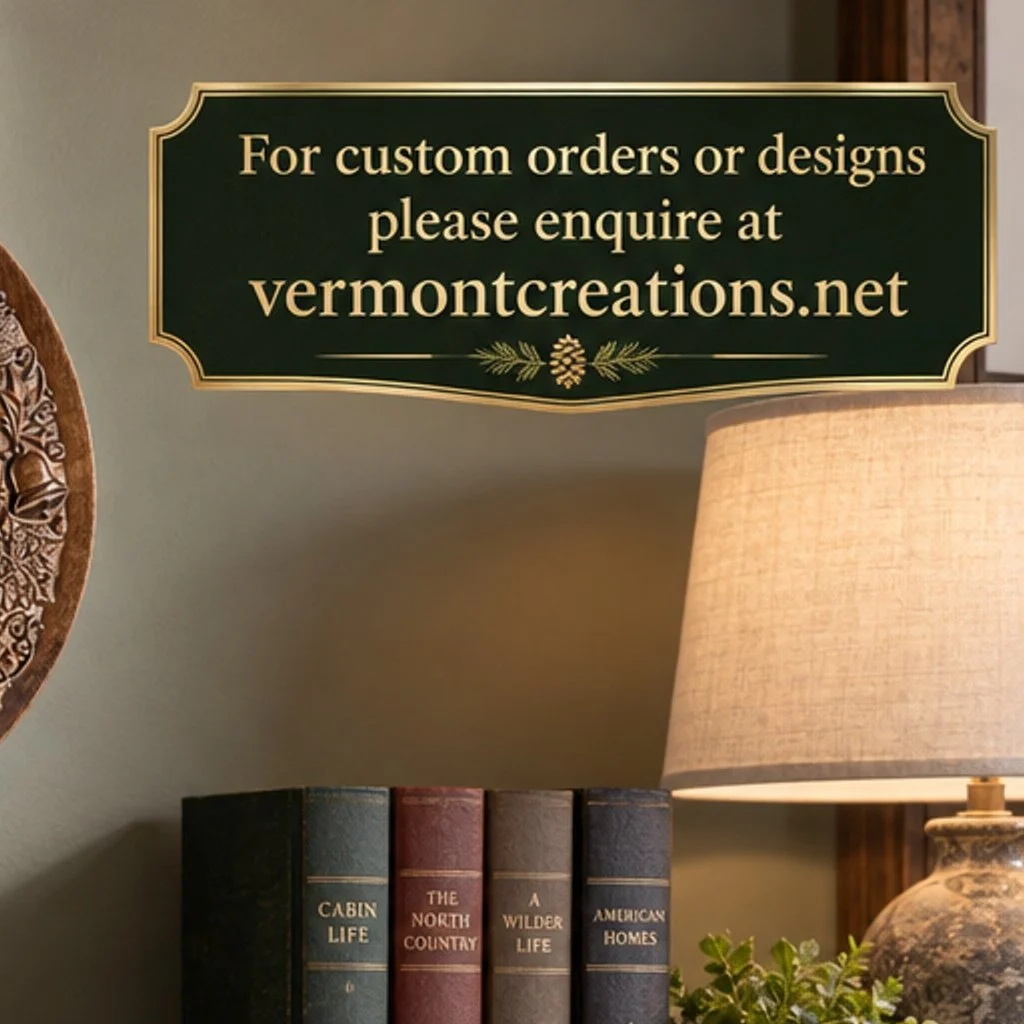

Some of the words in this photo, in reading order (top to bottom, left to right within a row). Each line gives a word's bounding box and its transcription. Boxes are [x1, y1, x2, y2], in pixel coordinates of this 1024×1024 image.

[427, 889, 460, 906] THE
[528, 892, 540, 907] A
[317, 901, 377, 920] CABIN
[592, 907, 666, 923] AMERICAN
[411, 912, 471, 929] NORTH
[502, 914, 564, 931] WILDER
[328, 925, 370, 944] LIFE
[603, 929, 658, 946] HOMES
[403, 935, 478, 952] COUNTRY
[516, 937, 552, 954] LIFE
